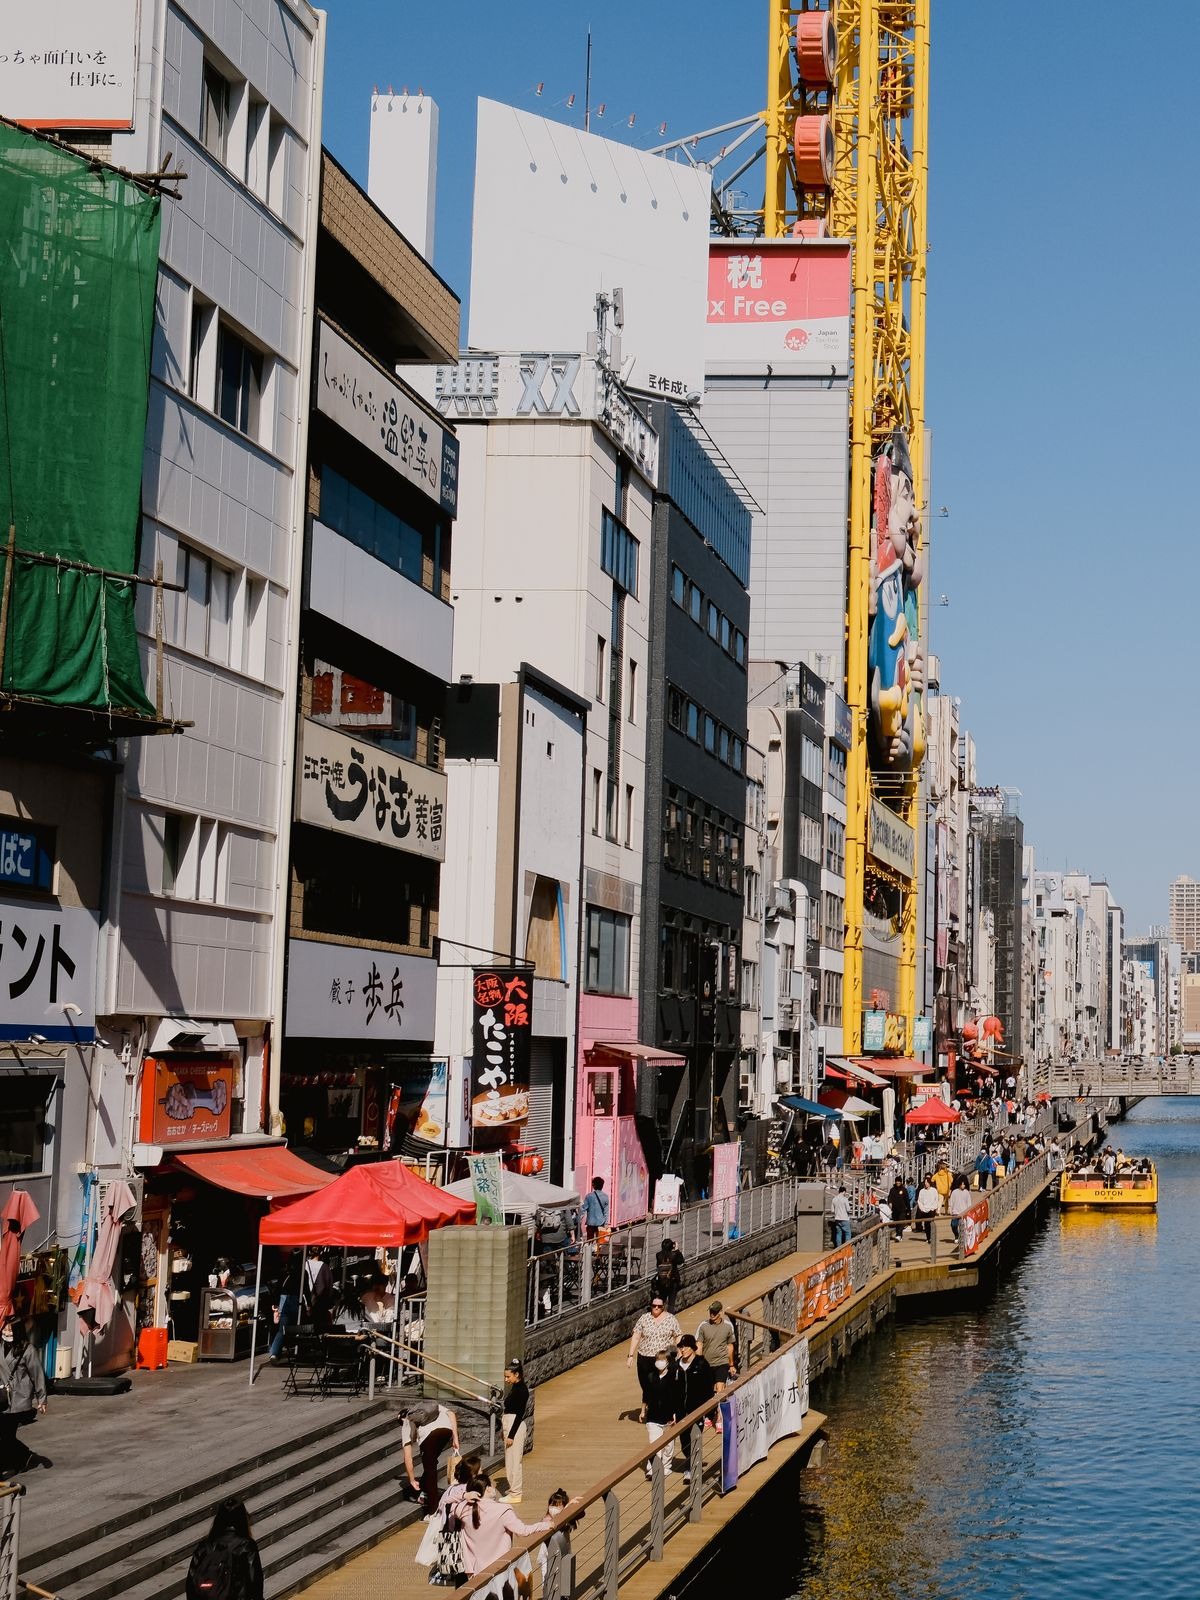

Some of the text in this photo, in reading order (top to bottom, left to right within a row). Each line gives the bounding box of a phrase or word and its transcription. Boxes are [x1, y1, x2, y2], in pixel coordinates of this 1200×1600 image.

[727, 255, 762, 289] 税
[734, 296, 787, 316] Free
[325, 746, 414, 839] うなぎ
[415, 794, 443, 842] 菱富
[0, 833, 32, 878] ばこ
[0, 923, 76, 1003] ント
[329, 961, 405, 1027] 餃子 歩兵
[475, 977, 499, 993] 大阪
[479, 989, 502, 1004] 名物
[504, 976, 529, 1026] 大阪
[167, 1120, 218, 1136] おおさか チーズドッグ
